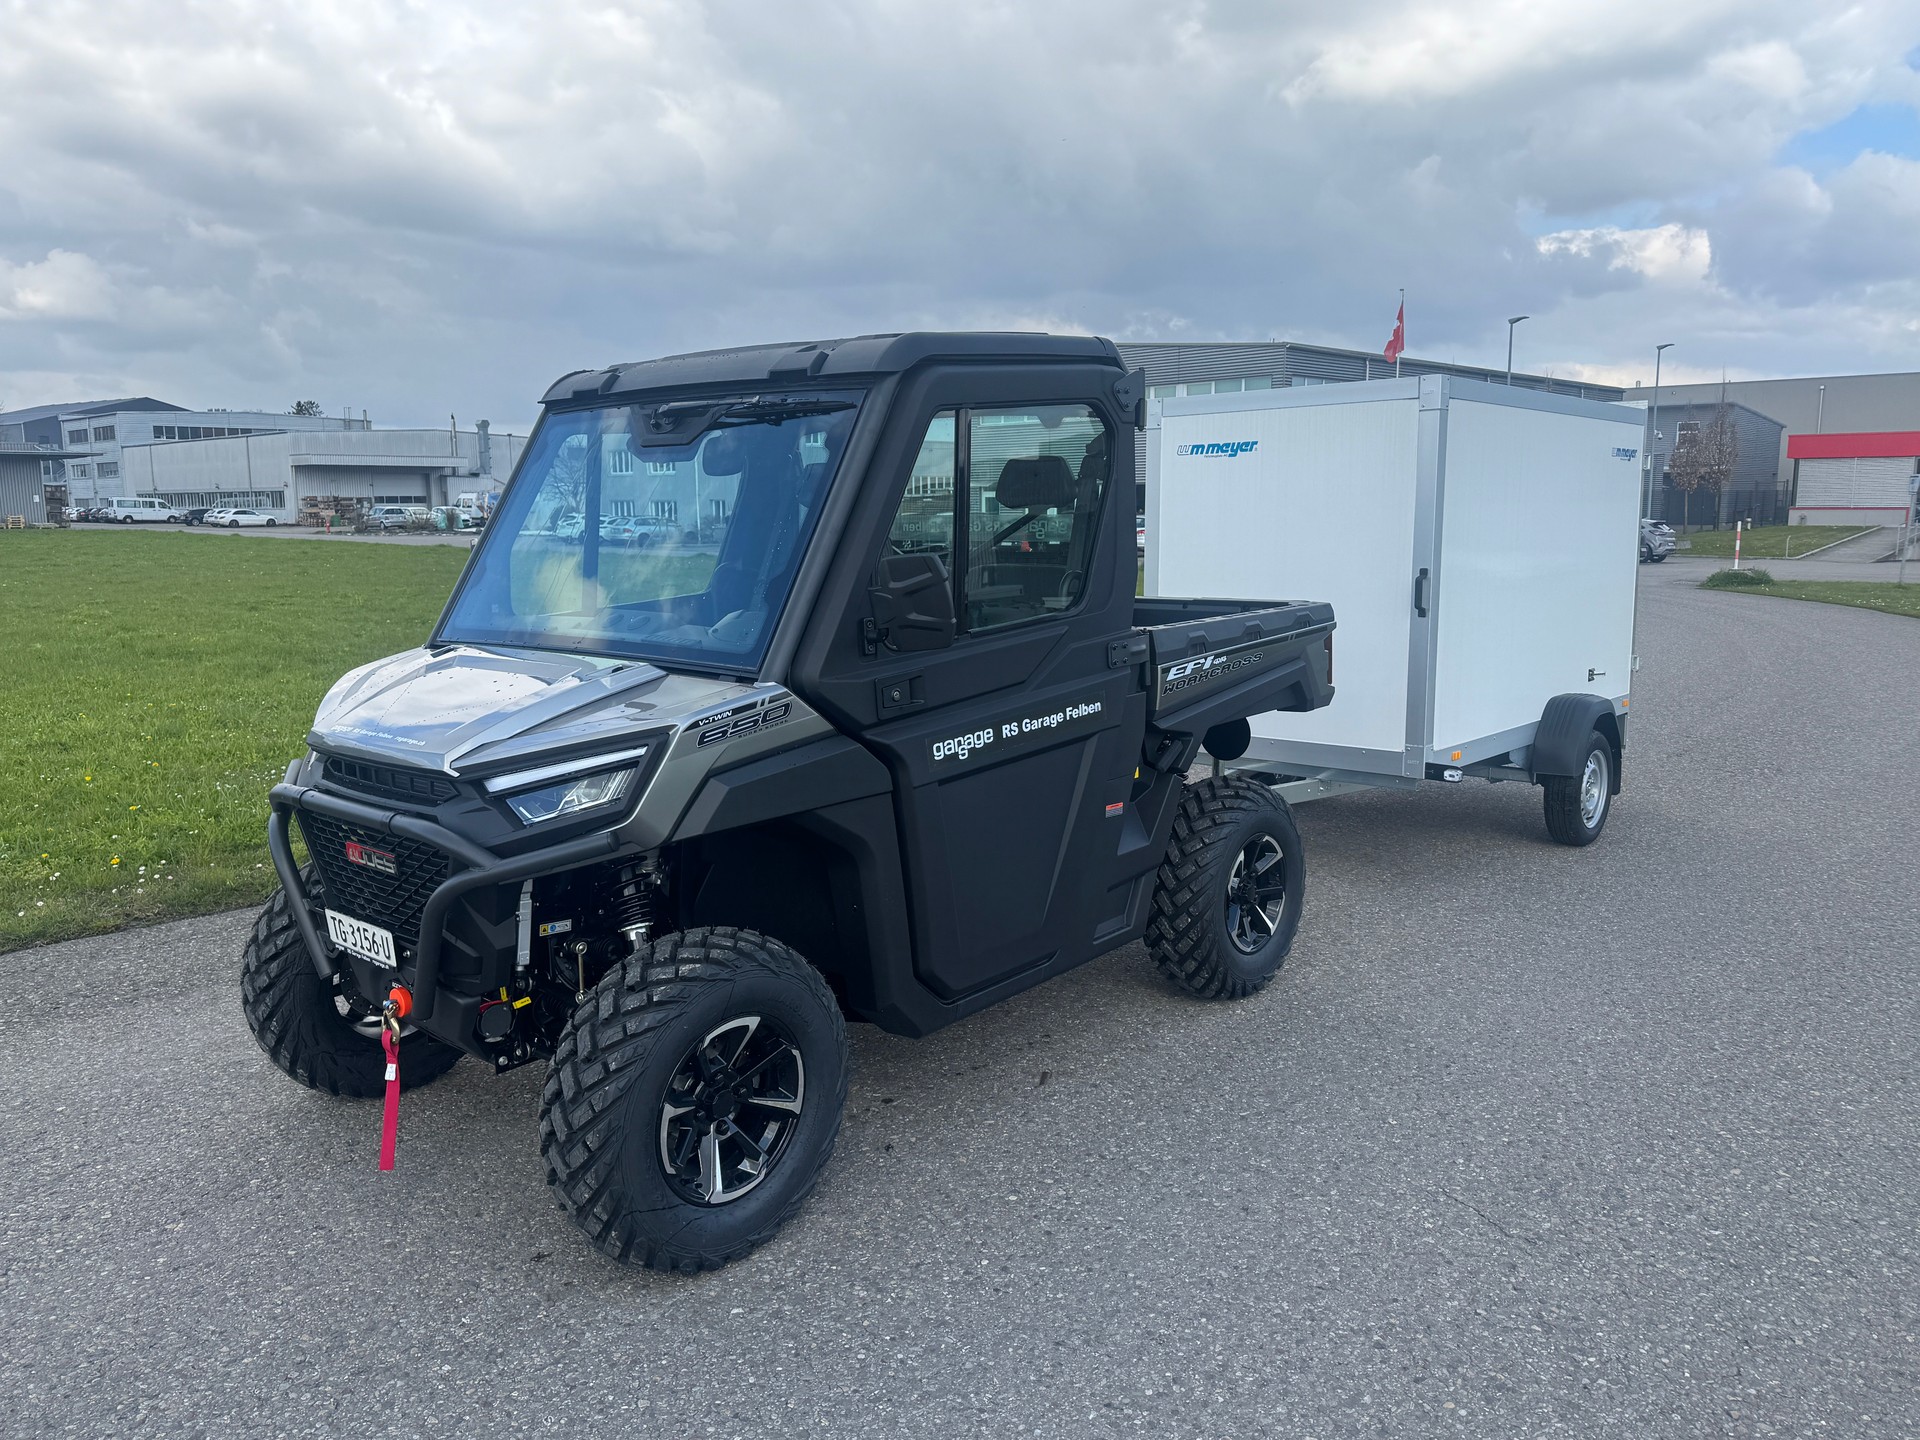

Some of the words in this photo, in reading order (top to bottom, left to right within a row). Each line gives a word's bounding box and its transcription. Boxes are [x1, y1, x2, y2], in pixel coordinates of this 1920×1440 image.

[1161, 652, 1263, 696] WORKCROSS
[1166, 655, 1214, 681] EFI
[696, 700, 793, 748] 650
[699, 709, 733, 726] V-TWIN
[1002, 722, 1019, 738] RS
[1022, 711, 1064, 732] Garage
[1066, 701, 1102, 720] Felben
